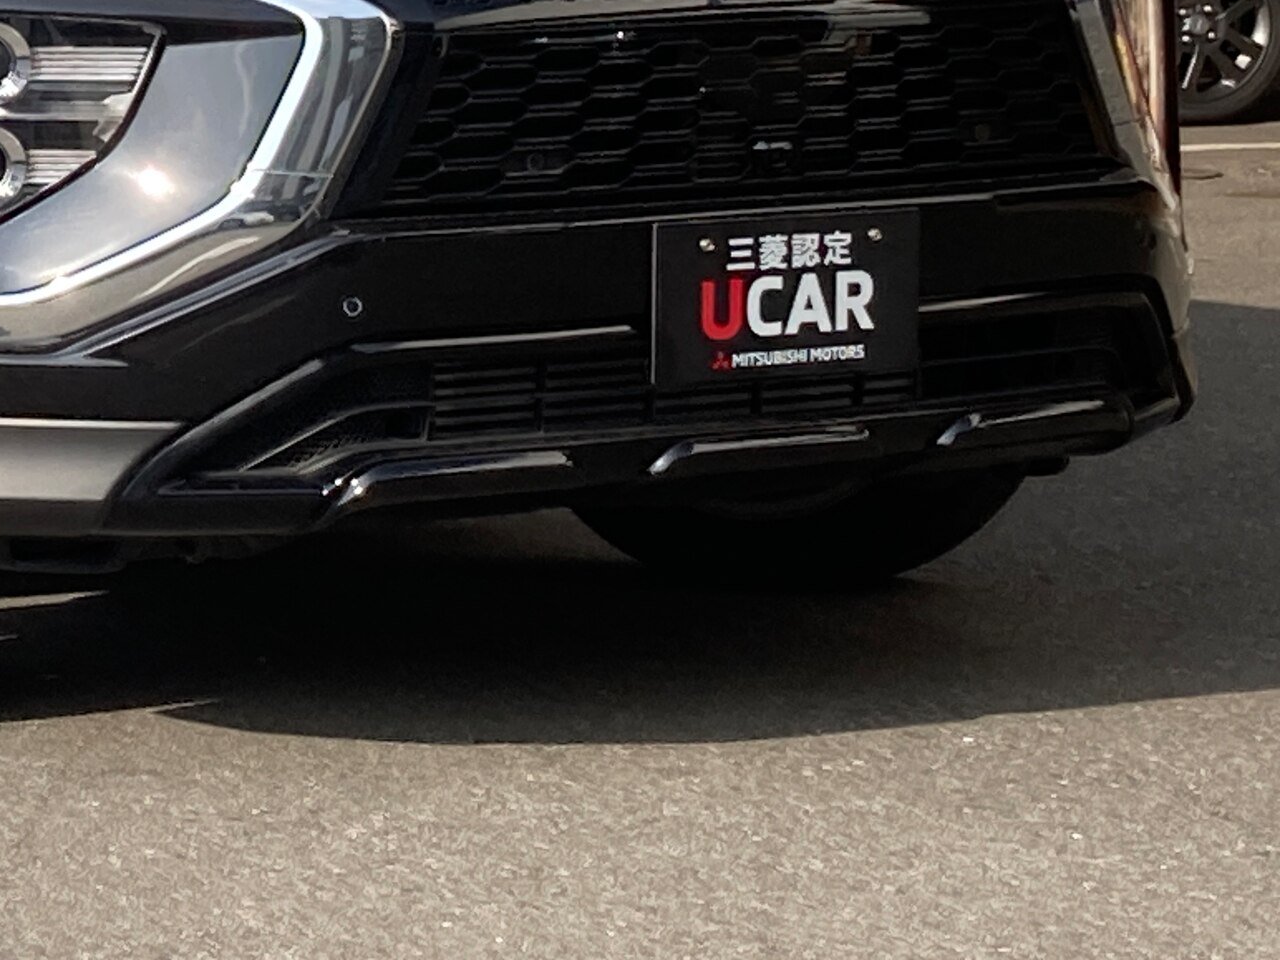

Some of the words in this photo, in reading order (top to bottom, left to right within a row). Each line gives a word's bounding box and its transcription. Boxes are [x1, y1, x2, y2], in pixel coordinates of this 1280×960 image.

[725, 230, 852, 271] 三菱認定
[701, 269, 875, 341] UCAR
[731, 348, 808, 368] MITSUBISHI
[809, 344, 865, 362] MOTORS
